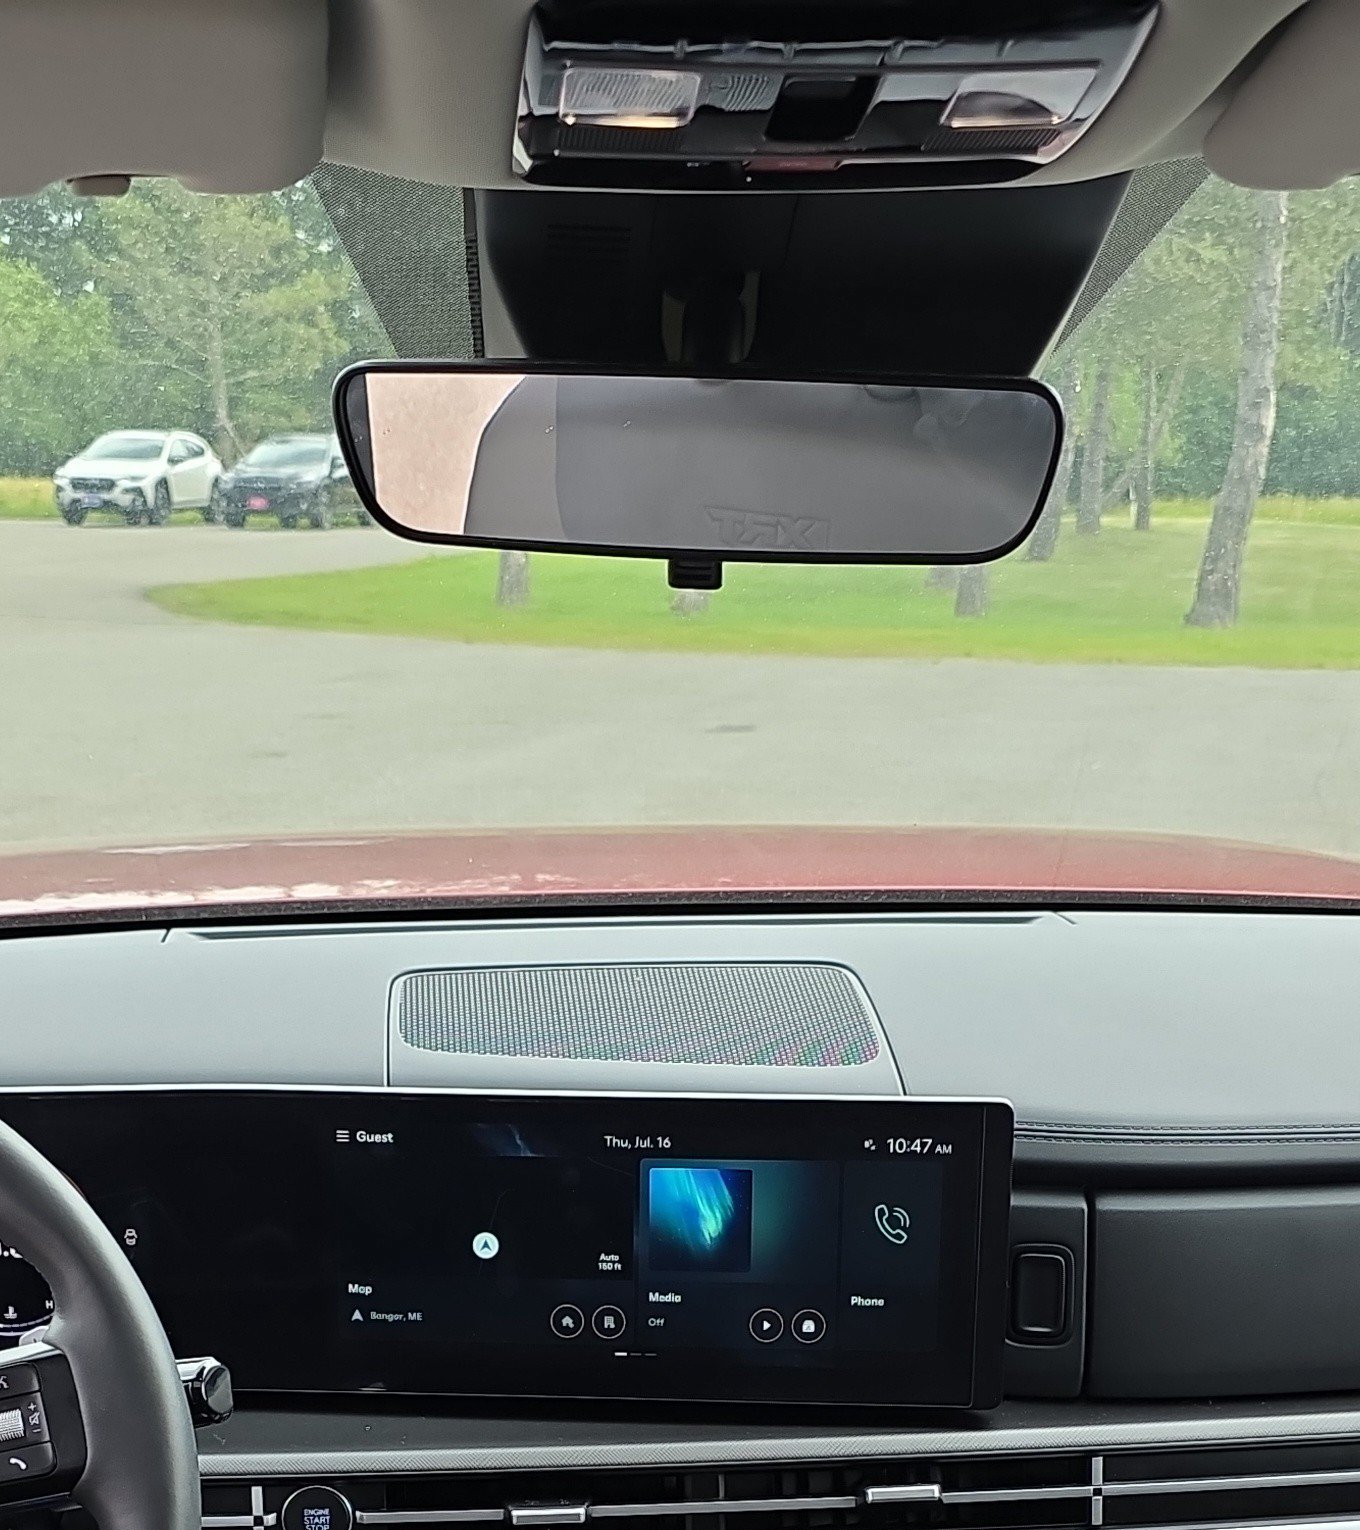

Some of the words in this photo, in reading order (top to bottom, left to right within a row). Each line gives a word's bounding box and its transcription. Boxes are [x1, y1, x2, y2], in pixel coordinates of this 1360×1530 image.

[355, 1131, 394, 1143] Guest
[604, 1135, 632, 1149] Thu,
[634, 1136, 654, 1148] Jul.
[657, 1137, 671, 1149] 16
[886, 1138, 933, 1154] 10:47
[935, 1144, 952, 1154] AM
[599, 1253, 619, 1262] Auto
[348, 1283, 372, 1296] Map
[648, 1292, 681, 1303] Media
[850, 1296, 884, 1307] Phone
[45, 1300, 53, 1310] H
[370, 1311, 406, 1323] Bangor,
[408, 1312, 423, 1322] ME
[648, 1318, 665, 1327] Off
[303, 1508, 330, 1516] ENGINE
[303, 1515, 331, 1525] START
